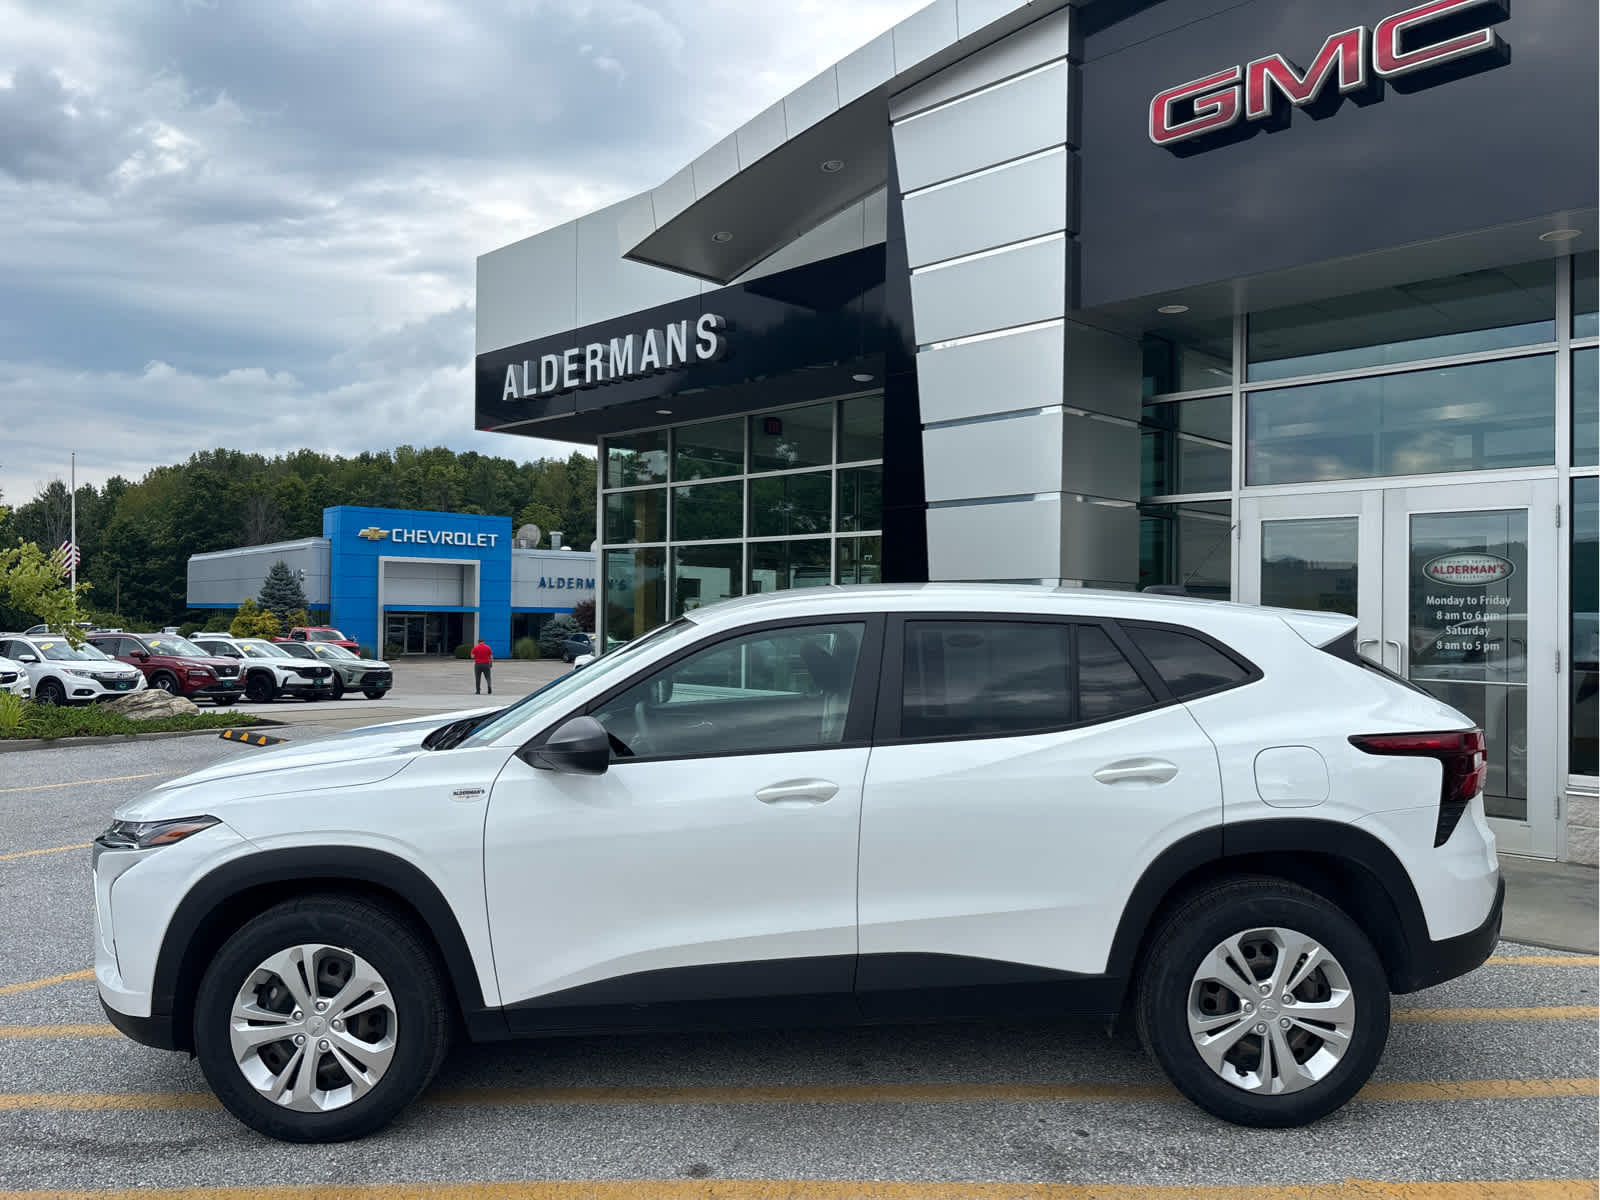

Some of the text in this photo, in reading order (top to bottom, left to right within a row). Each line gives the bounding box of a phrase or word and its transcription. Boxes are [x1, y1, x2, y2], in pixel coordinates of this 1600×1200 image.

[1149, 0, 1501, 148] GMC
[502, 312, 724, 401] ALDERMANS
[391, 528, 500, 548] CHEVROLET
[1431, 564, 1507, 575] ALDERMAN'S
[1426, 595, 1511, 607] Monday to Friday
[1436, 611, 1500, 622] 8 am to 6 pm
[1446, 625, 1490, 637] Saturday
[1436, 641, 1500, 652] 8 am to 5 pm
